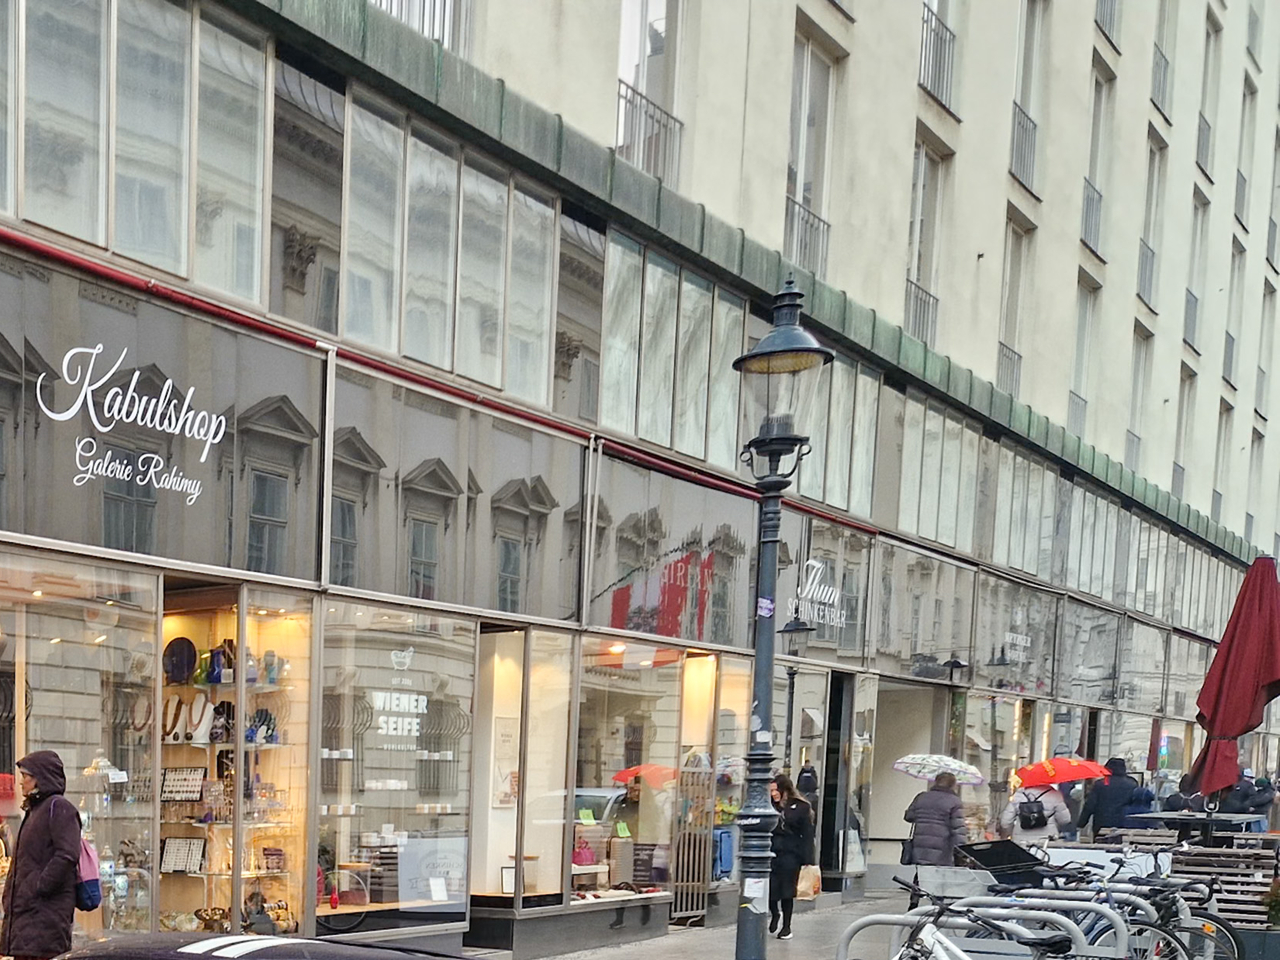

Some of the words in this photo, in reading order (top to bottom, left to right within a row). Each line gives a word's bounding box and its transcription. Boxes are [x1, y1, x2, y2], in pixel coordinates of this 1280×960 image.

[35, 343, 227, 463] Kabulshop
[72, 436, 133, 487] Galerie
[136, 453, 203, 506] Rahimy
[797, 559, 840, 606] Thum
[787, 597, 846, 628] SCHINKENBAR
[372, 691, 428, 714] WIENER
[377, 715, 420, 737] SEIFE
